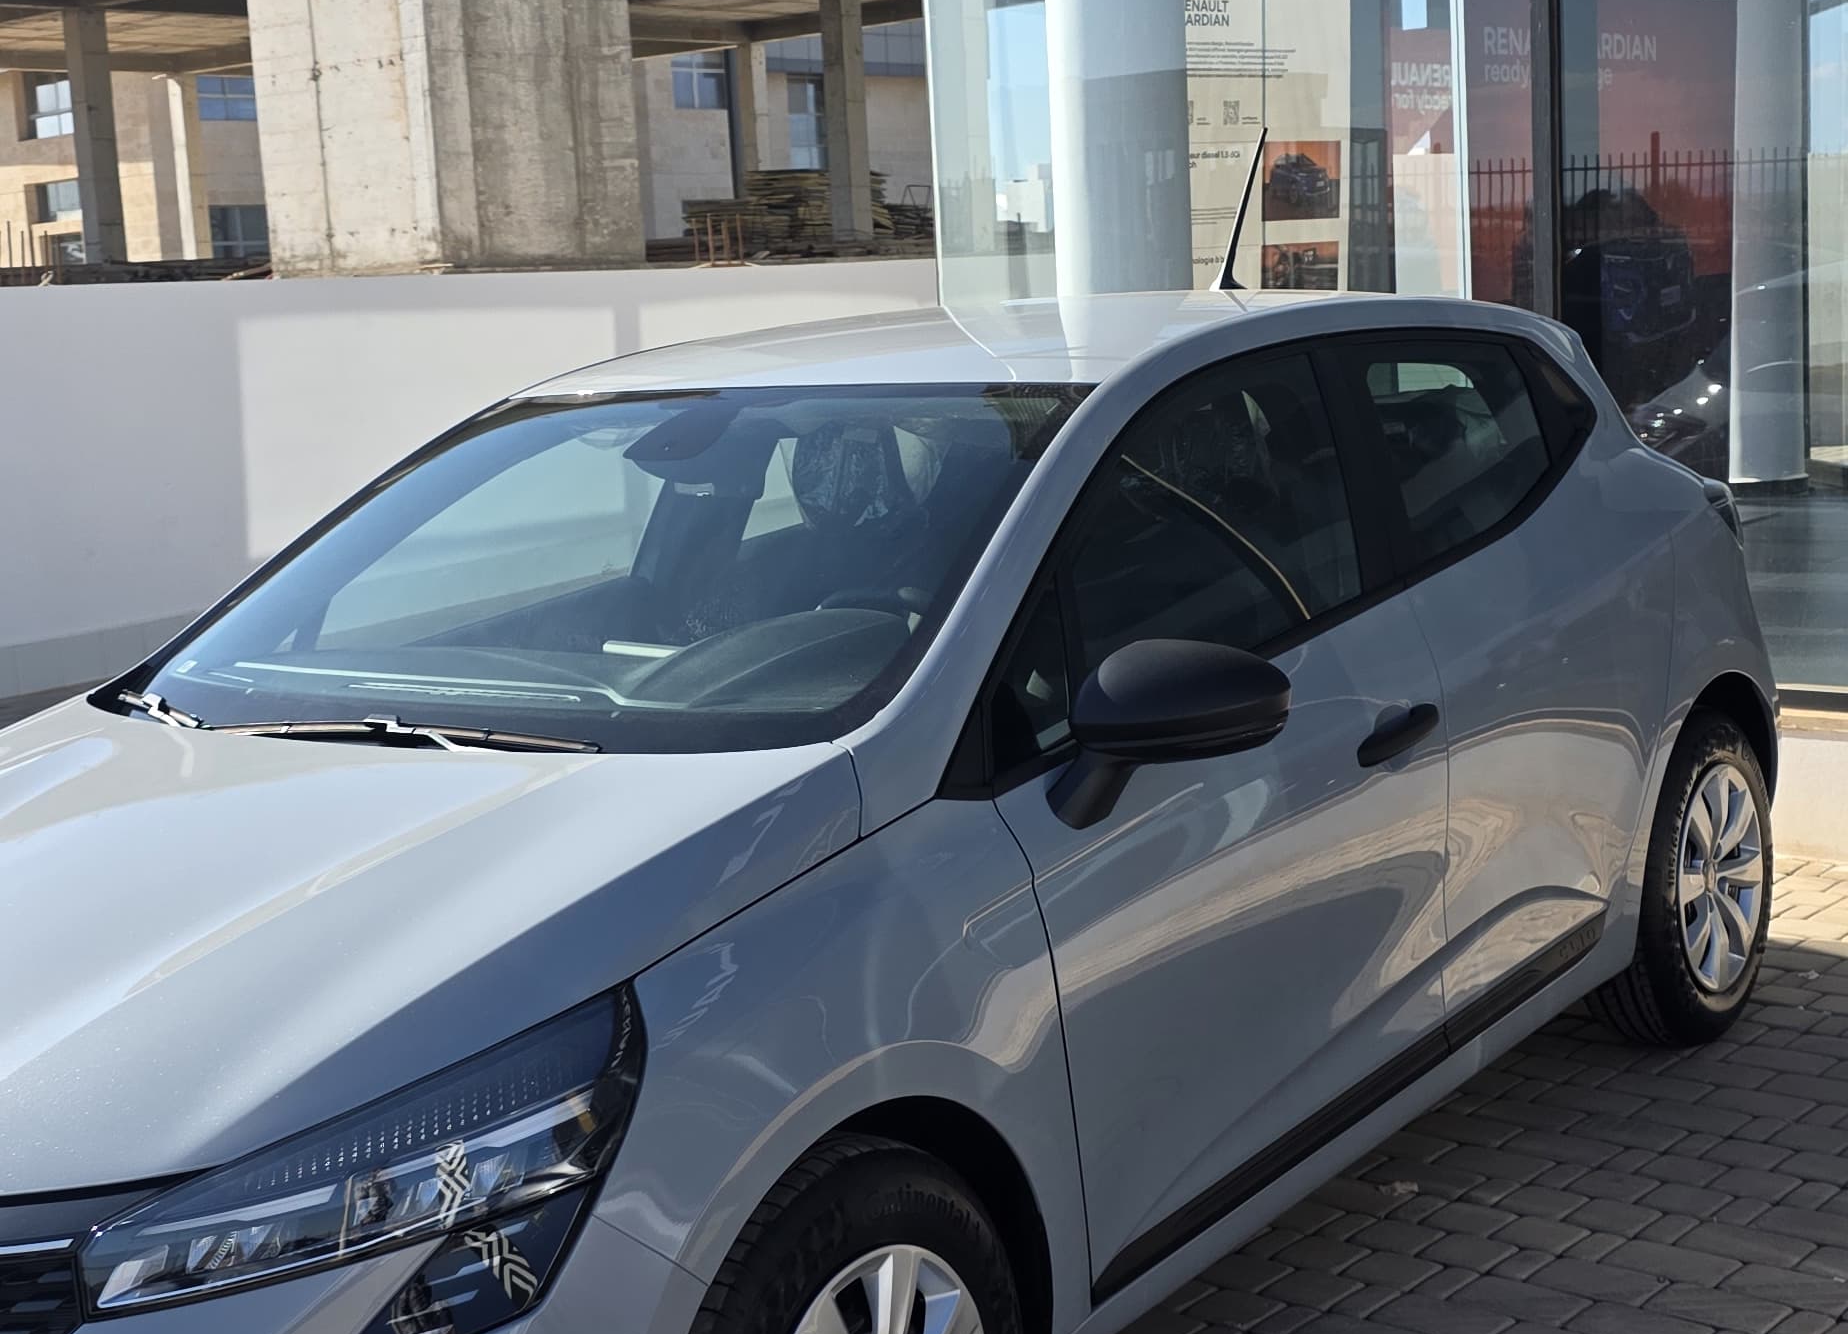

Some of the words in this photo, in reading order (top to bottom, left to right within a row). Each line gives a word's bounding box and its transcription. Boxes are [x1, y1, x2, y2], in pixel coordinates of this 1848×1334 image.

[1184, 0, 1229, 13] ENAULT
[1185, 13, 1230, 27] ARDIAN
[1483, 27, 1531, 56] RENA
[1597, 32, 1657, 62] RDIAN
[1192, 256, 1214, 266] nologie
